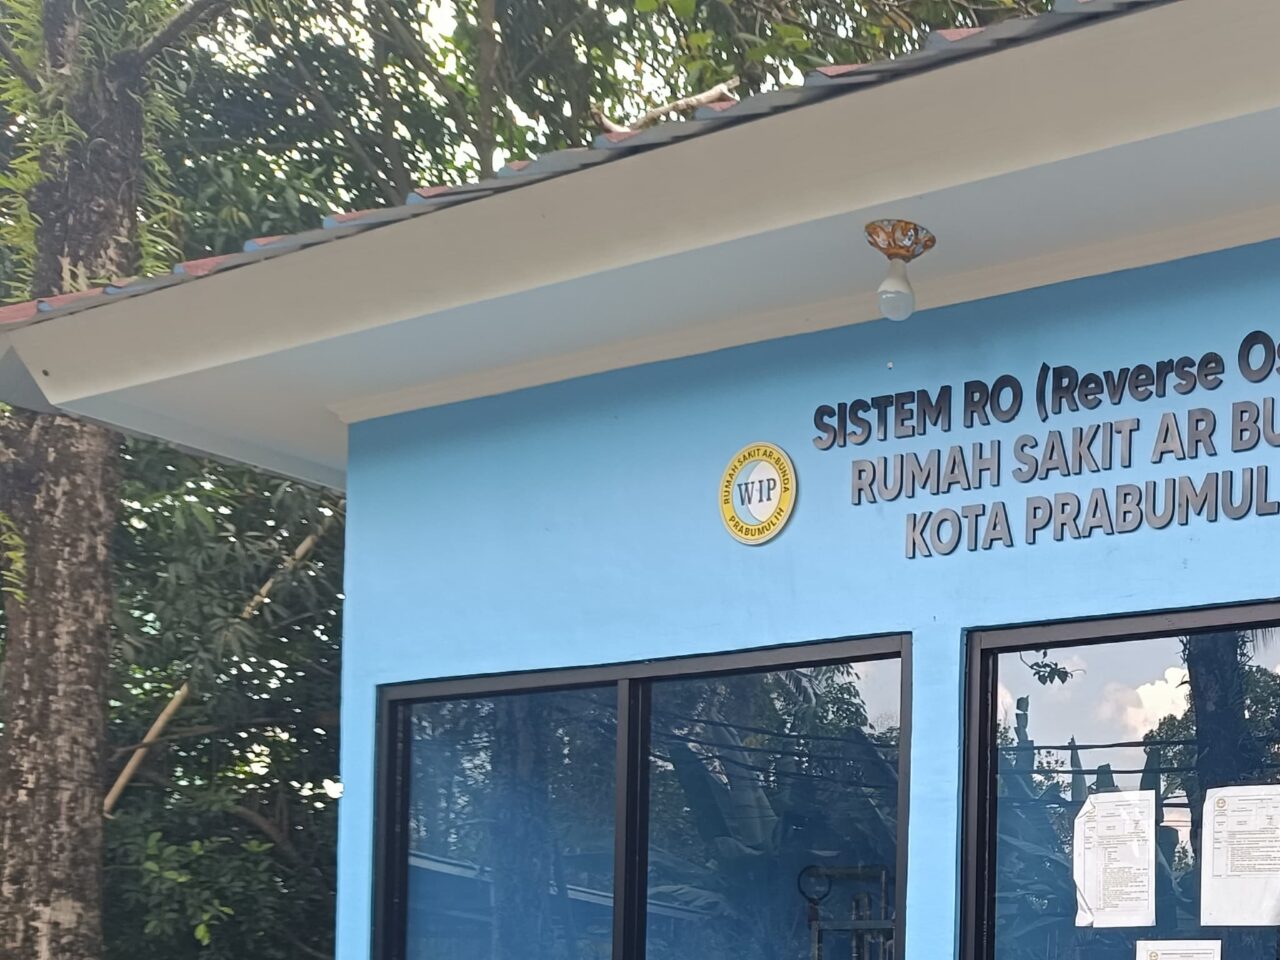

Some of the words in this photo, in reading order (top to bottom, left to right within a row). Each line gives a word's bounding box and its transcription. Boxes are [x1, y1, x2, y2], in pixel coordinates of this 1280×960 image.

[812, 385, 952, 450] SISTEM
[963, 374, 1023, 428] RO
[1036, 352, 1225, 422] (Reverse
[723, 465, 738, 504] RUMAH
[737, 448, 761, 467] SAKIT
[762, 449, 790, 493] AR-BUNDA
[851, 440, 1000, 505] RUMAH
[1012, 418, 1139, 483] SAKIT
[1151, 408, 1217, 464] AR
[737, 478, 777, 506] WIP
[728, 507, 785, 537] PRABUMULIH
[905, 501, 1013, 559] KOTA
